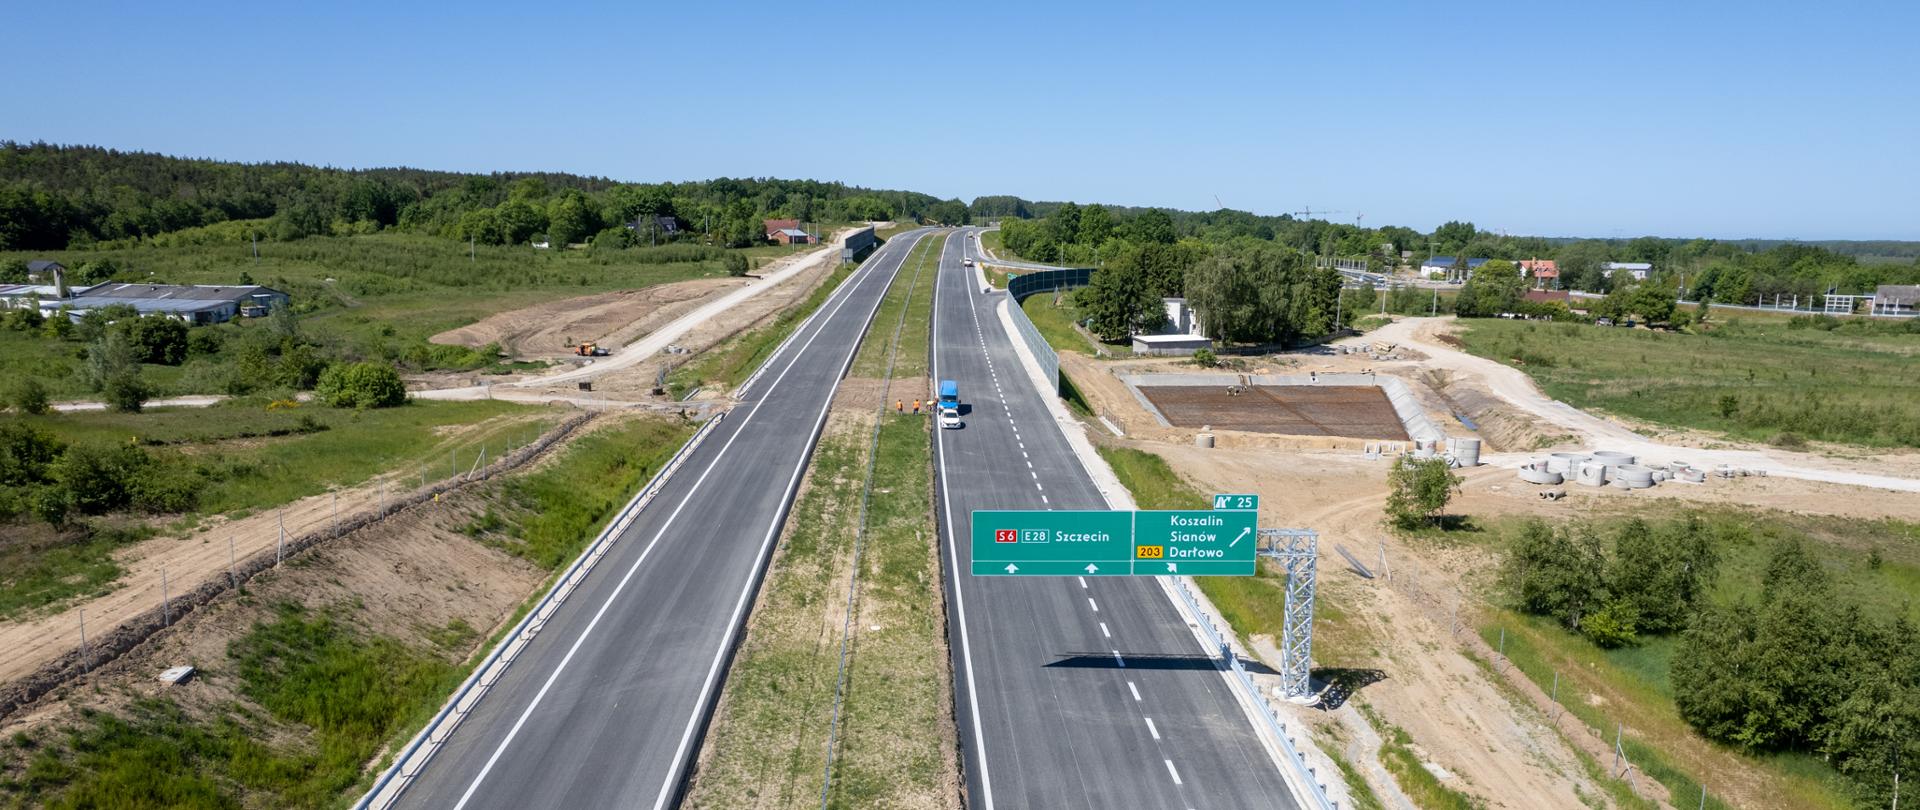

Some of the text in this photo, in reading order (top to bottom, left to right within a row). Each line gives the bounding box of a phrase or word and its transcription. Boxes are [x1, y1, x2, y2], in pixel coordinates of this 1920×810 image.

[1237, 497, 1252, 508] 25
[1170, 515, 1223, 526] Koszalin
[1055, 530, 1109, 542] Szczecin
[1170, 531, 1217, 542] Sianów
[1140, 546, 1224, 558] 203 Darłowo
